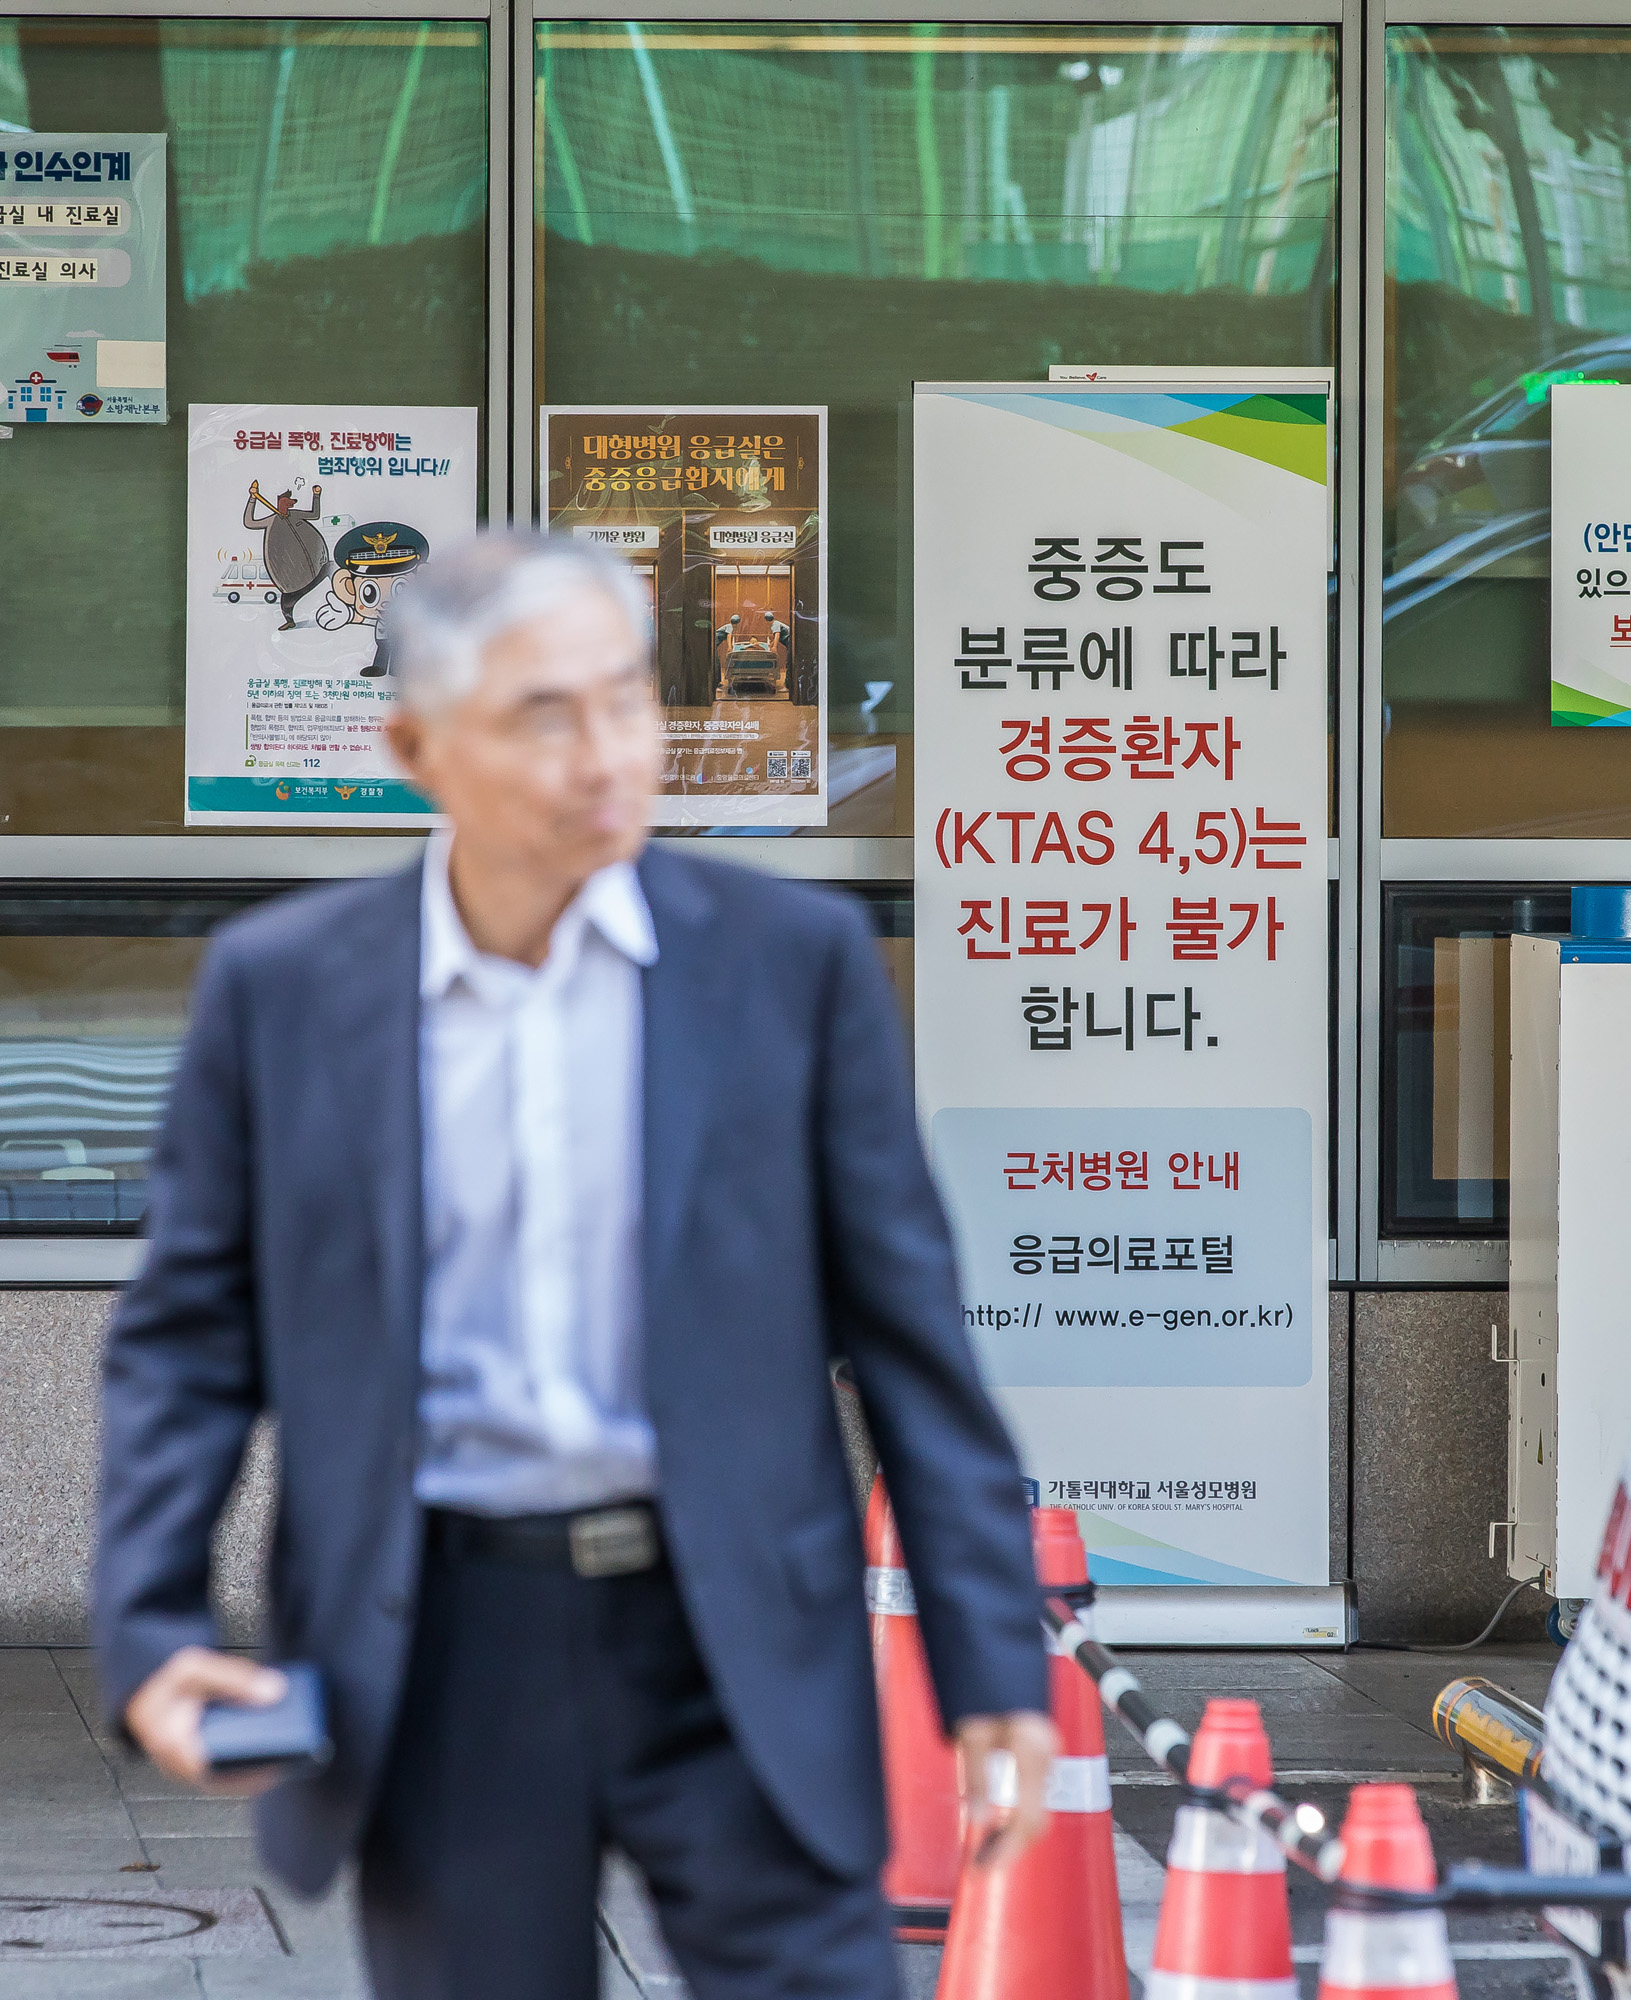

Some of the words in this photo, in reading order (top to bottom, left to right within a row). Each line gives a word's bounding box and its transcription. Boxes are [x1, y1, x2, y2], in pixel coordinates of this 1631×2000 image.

[14, 151, 131, 182] 인수인계
[37, 205, 54, 223] 내
[65, 206, 119, 226] 진료실
[0, 261, 47, 281] 진료실
[60, 262, 97, 280] 의사
[105, 404, 160, 415] 소방재난본부
[233, 430, 282, 450] 응급실
[287, 431, 324, 451] 폭행,
[330, 431, 412, 452] 진료방해는
[583, 434, 681, 460] 대형병원
[688, 435, 786, 460] 응급실은
[317, 456, 382, 476] 범죄행위
[388, 457, 451, 477] 입니다!!
[583, 466, 785, 491] 중증응급환자에게
[588, 530, 620, 543] 가까운
[623, 530, 646, 543] 병원
[713, 530, 758, 544] 대형병원
[760, 530, 794, 544] 응급실
[1028, 538, 1211, 600] 중증도
[954, 626, 1133, 690] 분류에
[1169, 626, 1287, 690] 따라
[247, 678, 270, 689] 응급실
[273, 678, 290, 689] 폭행,
[293, 679, 322, 690] 진료방해
[325, 679, 333, 689] 및
[336, 679, 373, 690] 기물파괴는
[247, 690, 260, 700] 5년
[262, 690, 284, 699] 이하의
[287, 690, 302, 700] 징역
[305, 690, 320, 700] 또는
[353, 690, 375, 700] 이하의
[668, 720, 702, 732] 경증환자,
[999, 716, 1241, 781] 경증환자
[303, 758, 321, 768] 112
[294, 786, 328, 796] 보건복지부
[360, 787, 384, 796] 경찰청
[936, 808, 1115, 868] (KTAS
[1139, 807, 1307, 874] 4,5)는
[957, 897, 1137, 961] 진료가
[1165, 897, 1285, 961] 불가
[1021, 987, 1218, 1051] 합니다.
[1003, 1151, 1149, 1190] 근처병원
[1168, 1151, 1239, 1190] 안내
[1010, 1234, 1234, 1274] 응급의료포털
[1055, 1303, 1293, 1331] www.e-gen.or.kr)
[1048, 1480, 1151, 1499] 가톨릭대학교
[1157, 1480, 1257, 1499] 서울성모병원
[1063, 1503, 1096, 1511] CATHOLIC
[1097, 1503, 1116, 1511] UNIV.
[1117, 1503, 1127, 1511] OF
[1128, 1503, 1150, 1511] KOREA
[1152, 1503, 1172, 1511] SEOUL
[1174, 1503, 1184, 1511] ST.
[1185, 1503, 1211, 1511] MARY'S
[1212, 1503, 1243, 1511] HOSPITAL
